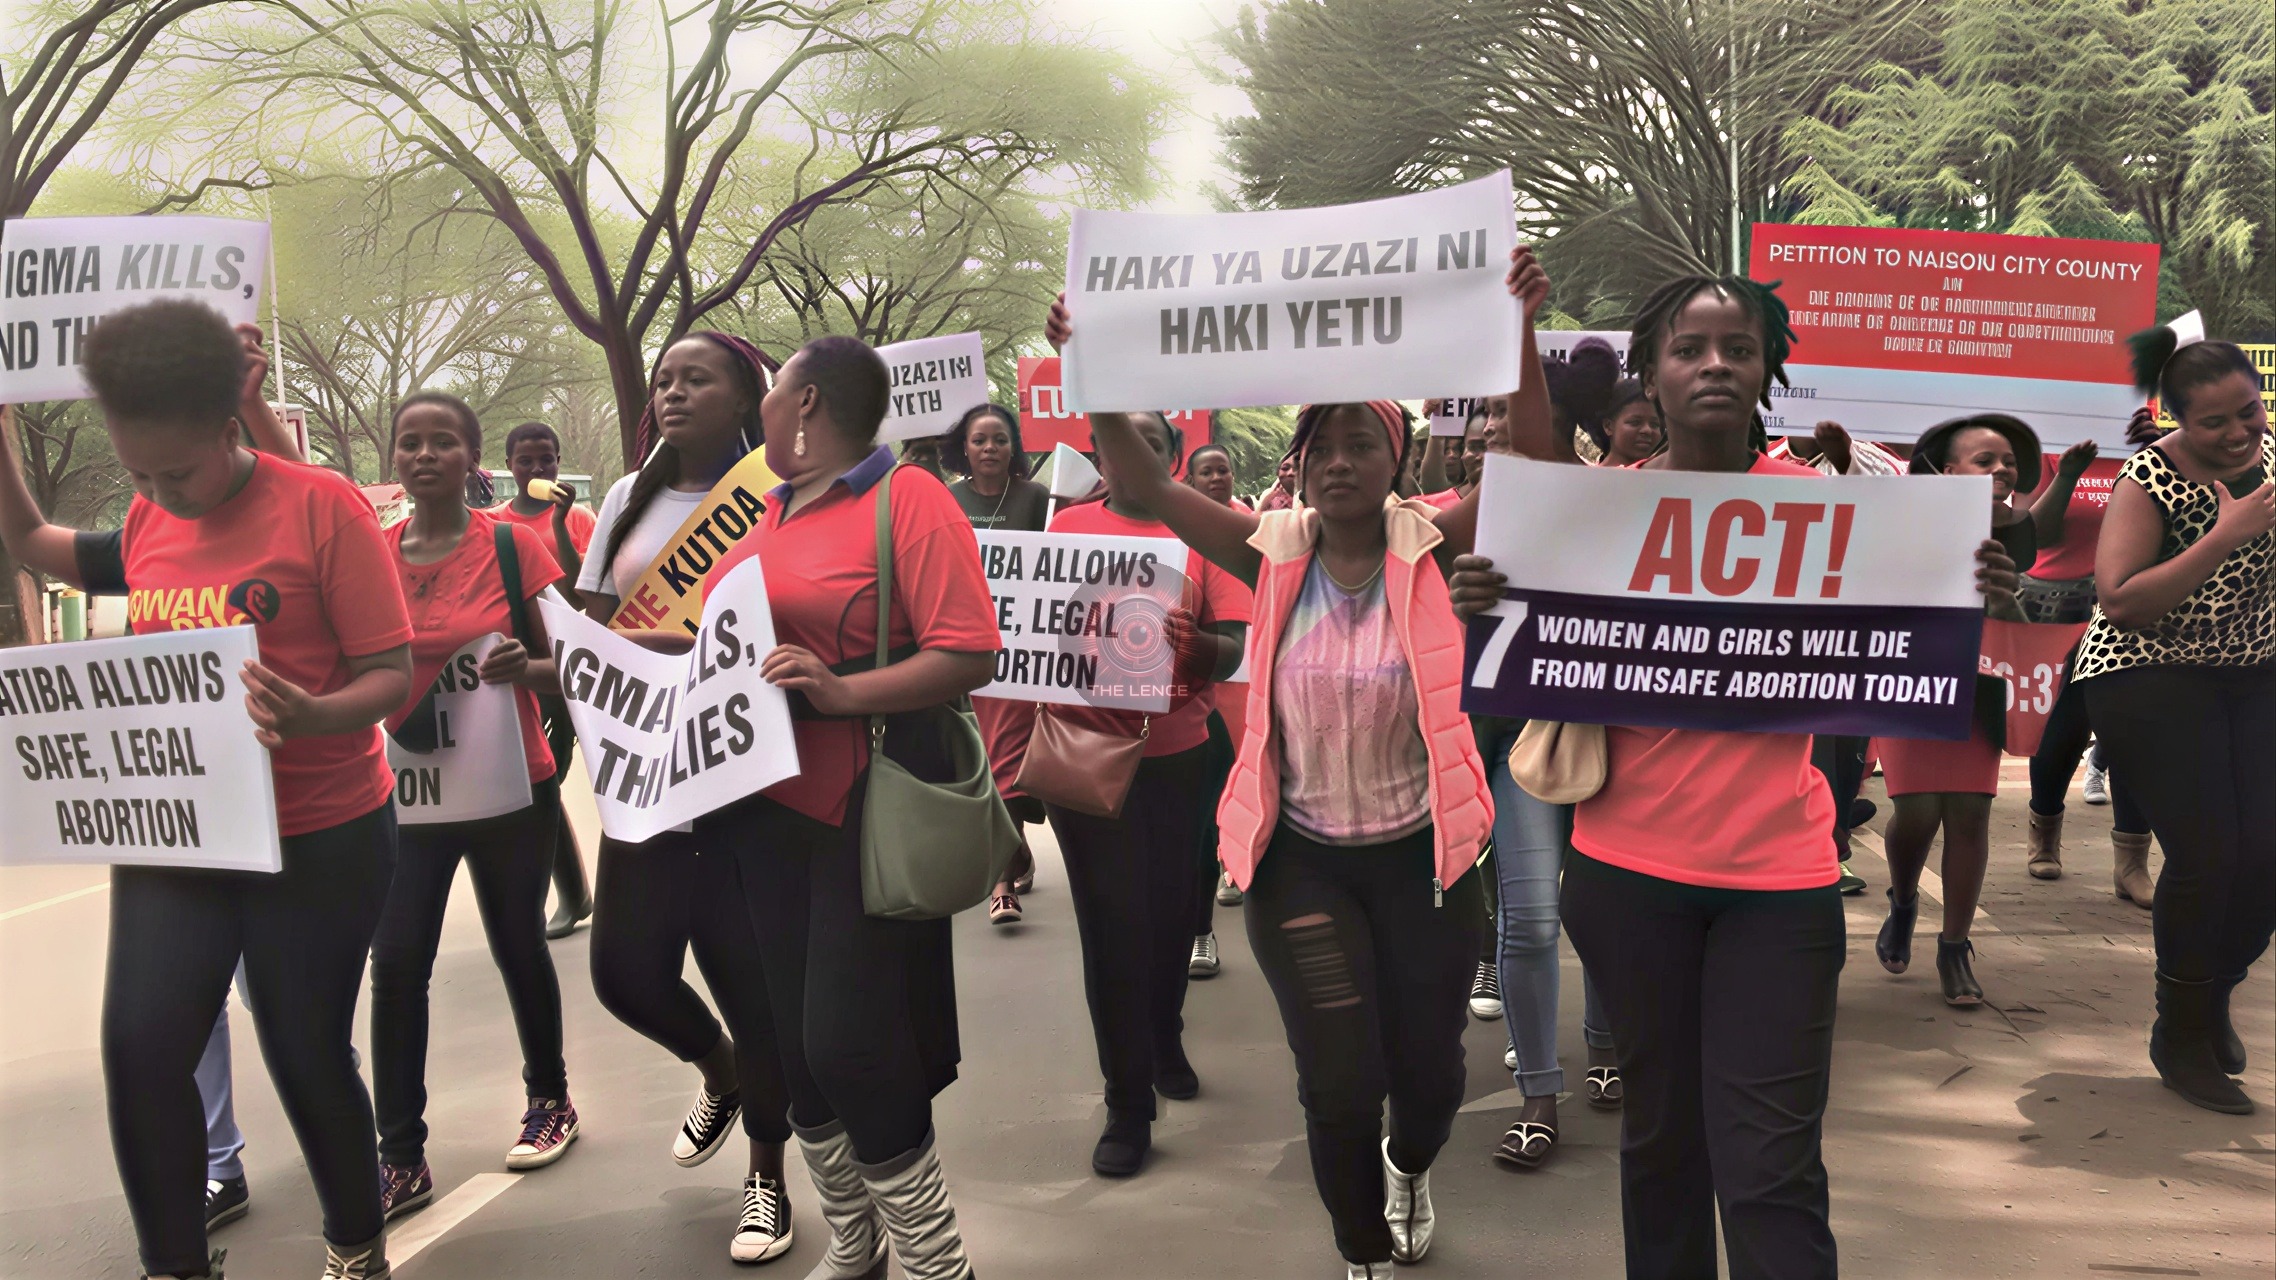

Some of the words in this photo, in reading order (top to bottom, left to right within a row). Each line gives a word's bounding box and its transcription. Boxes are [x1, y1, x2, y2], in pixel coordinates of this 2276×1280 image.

[115, 243, 255, 300] KILLS,
[1085, 254, 1194, 292] HAKI
[1212, 250, 1263, 286] YA
[1281, 237, 1419, 281] UZAZI
[1437, 228, 1487, 271] NI
[1874, 248, 1901, 267] TO
[2003, 255, 2051, 275] CITY
[2056, 259, 2142, 281] COUNTY
[1160, 304, 1268, 356] HAKI
[1285, 296, 1402, 350] YETU
[657, 485, 768, 599] KUTOA
[1032, 546, 1158, 589] ALLOWS
[1627, 496, 1856, 599] ACT!
[1031, 597, 1119, 639] LEGAL
[1471, 600, 1529, 690] 7
[1537, 614, 1645, 651] WOMEN
[1652, 624, 1711, 654] AND
[1717, 626, 1793, 658] GIRLS
[1802, 629, 1860, 658] WILL
[1867, 630, 1912, 659] DIE
[86, 651, 226, 709] ALLOWS
[1529, 658, 1608, 690] FROM
[1614, 663, 1721, 698] UNSAFE
[1724, 670, 1855, 702] ABORTION
[15, 731, 109, 784] SAFE,
[110, 727, 206, 778] LEGAL
[669, 692, 755, 789] LIES
[56, 798, 201, 849] ABORTION
